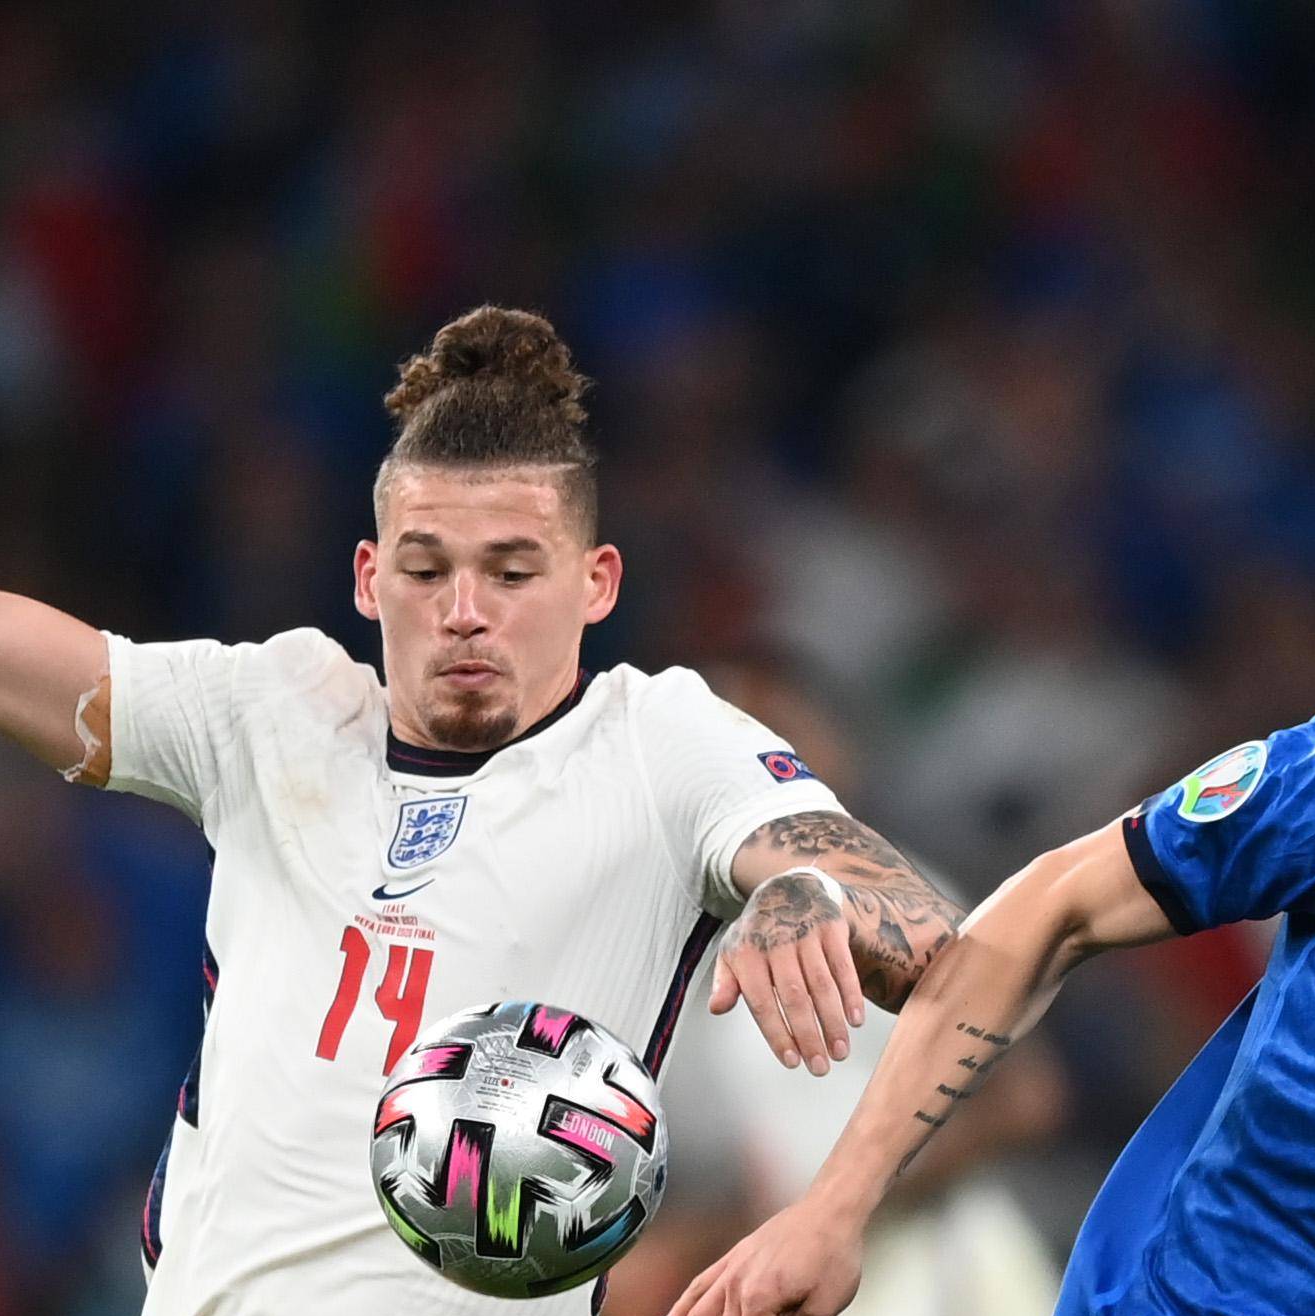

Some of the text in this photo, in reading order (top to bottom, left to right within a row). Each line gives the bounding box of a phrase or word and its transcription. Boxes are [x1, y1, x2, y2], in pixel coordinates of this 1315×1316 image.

[381, 903, 406, 914] ITALY
[376, 924, 396, 936] EURO
[413, 929, 436, 941] FINAL
[315, 925, 434, 1077] 14
[560, 1111, 616, 1151] LONDON
